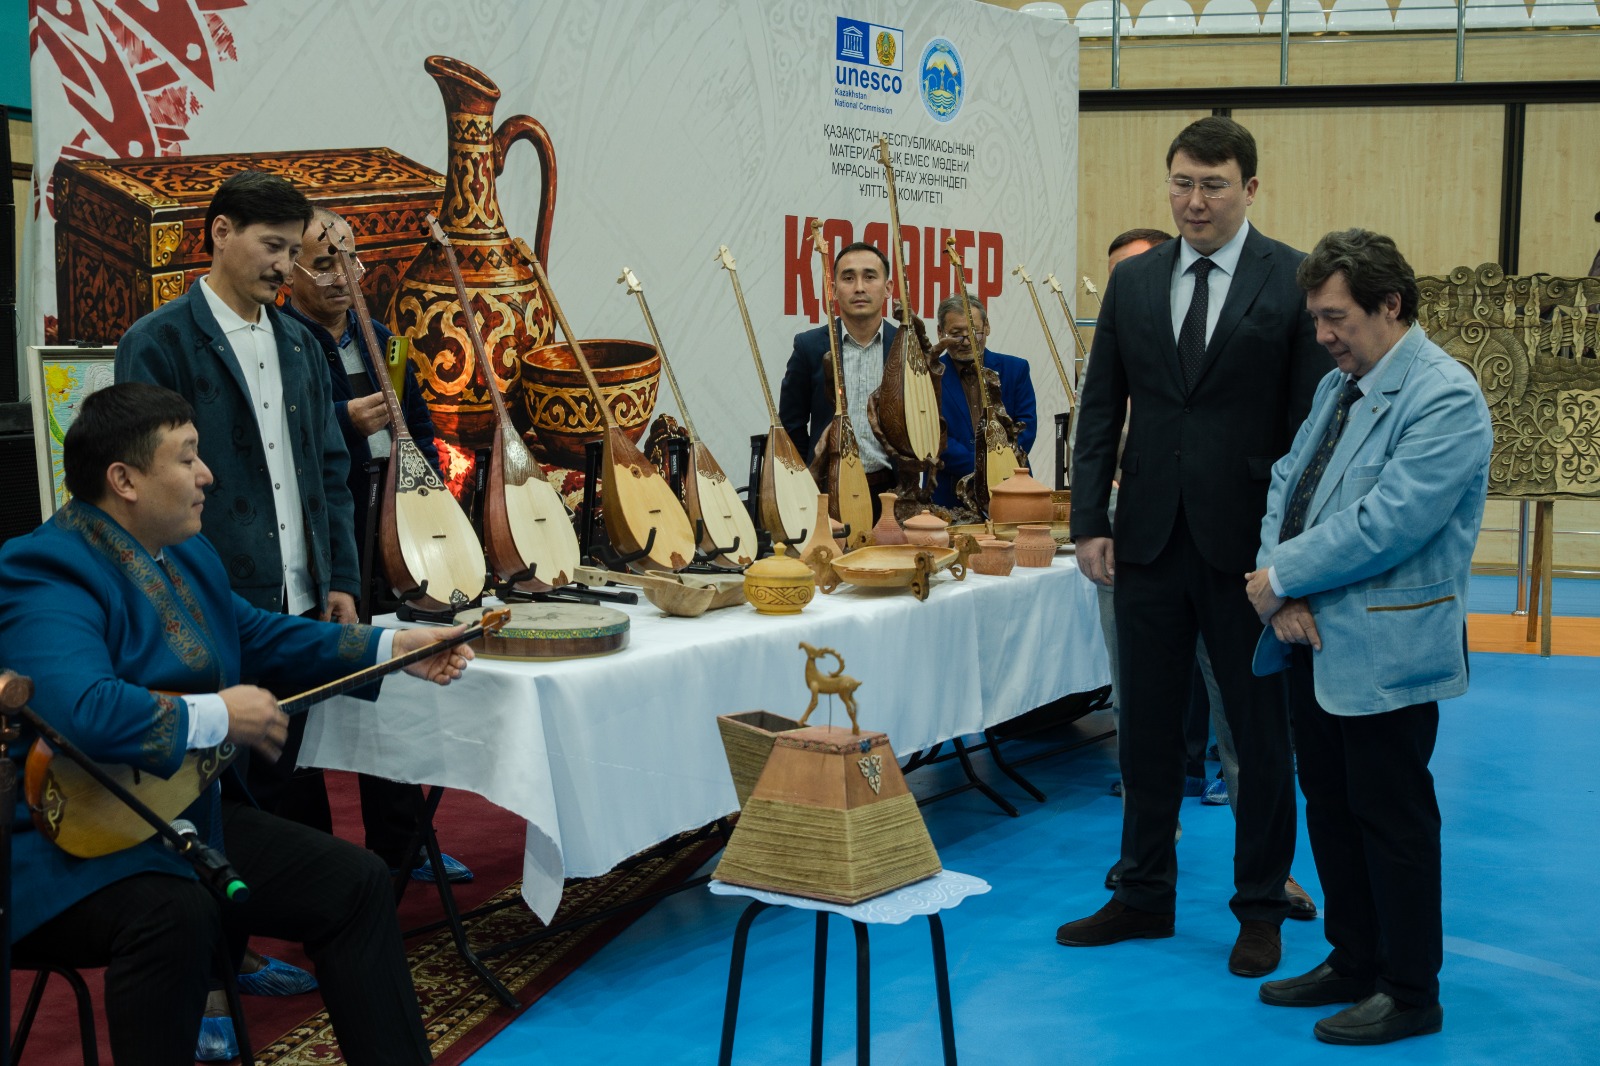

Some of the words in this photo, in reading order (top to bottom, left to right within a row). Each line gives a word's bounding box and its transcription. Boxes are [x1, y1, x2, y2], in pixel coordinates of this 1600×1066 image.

[836, 65, 903, 95] unesco
[834, 87, 868, 100] Kazakhstan
[834, 98, 858, 110] National
[859, 102, 893, 115] Commission
[823, 123, 880, 143] ҚАЗАҚСТАН
[829, 143, 902, 168] МАТЕРИАЛЫҚ
[904, 152, 930, 168] ЕМЕС
[932, 156, 970, 173] МӘДЕНИ
[882, 167, 917, 185] ҚРҒАУ
[898, 187, 943, 204] КОМИТЕТІ
